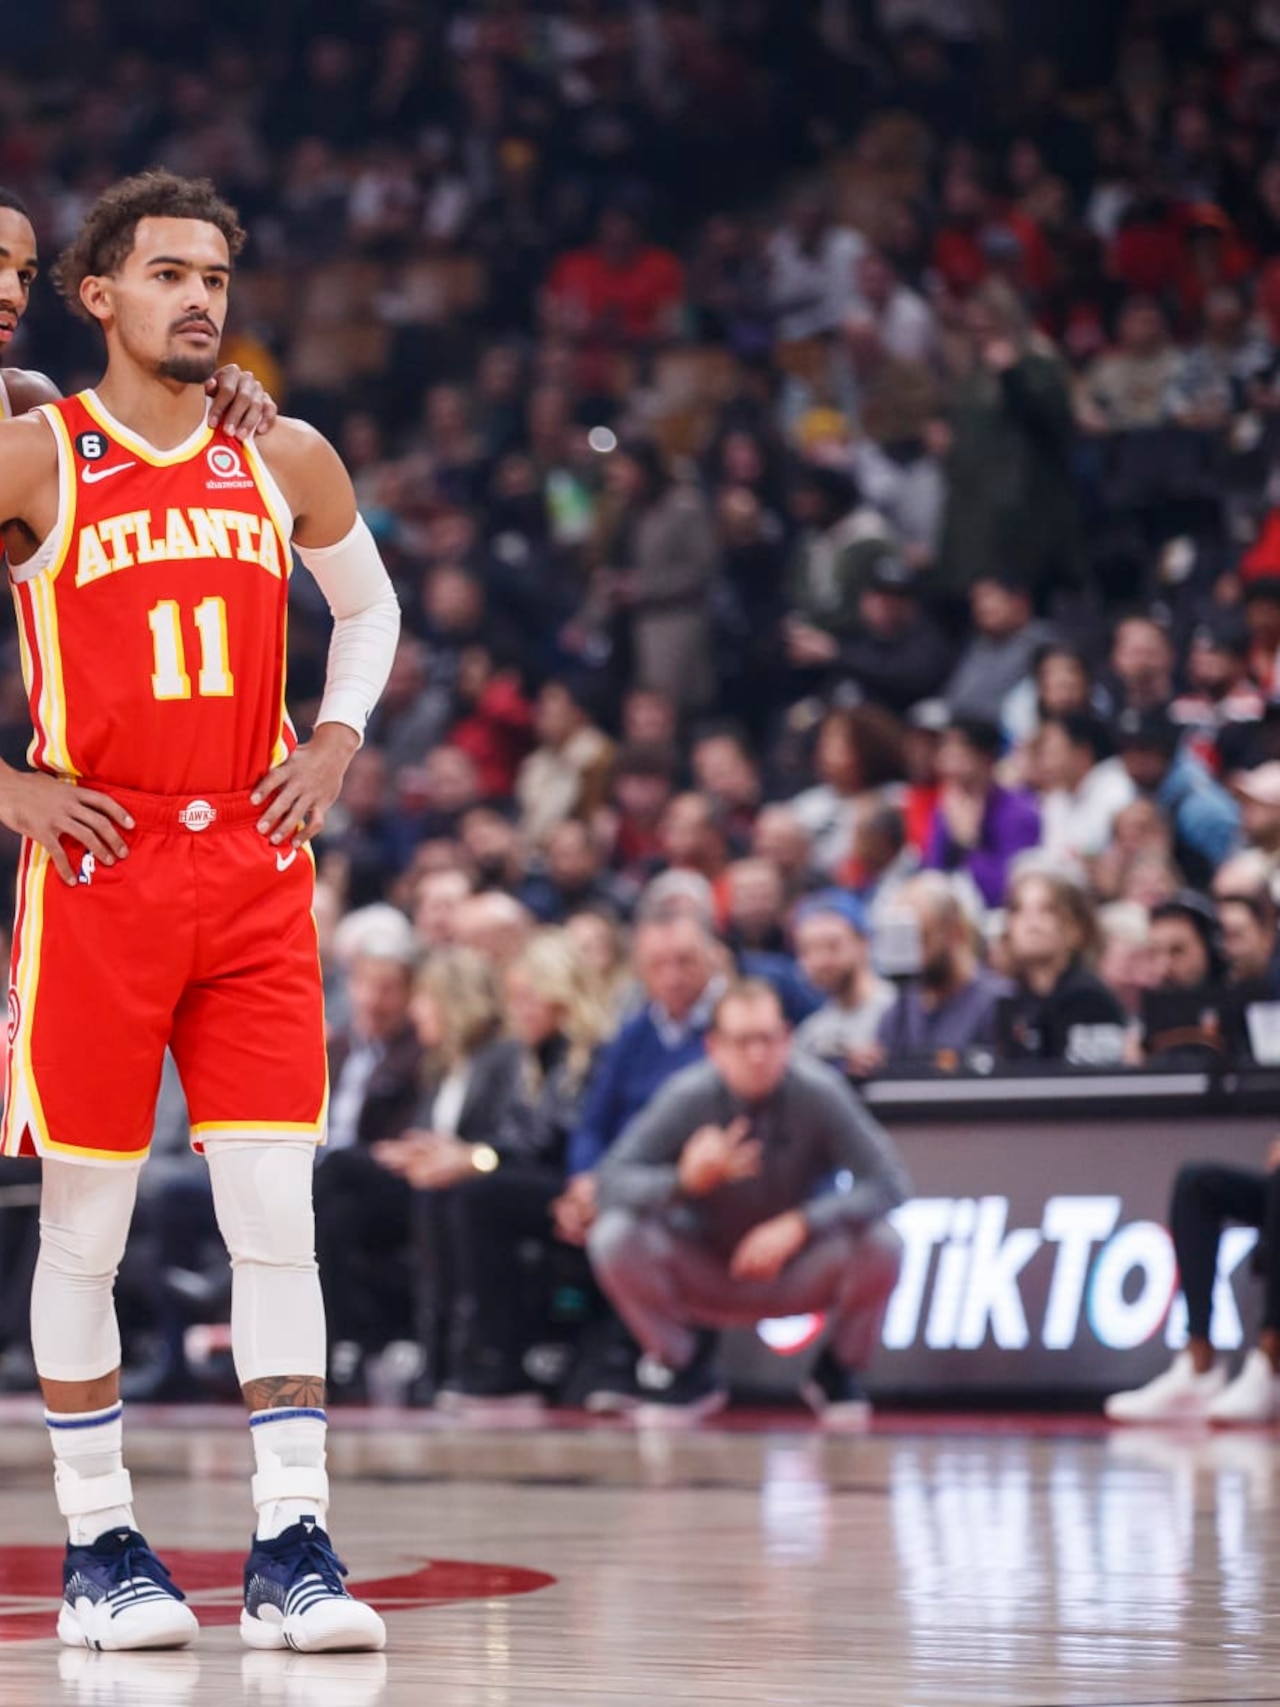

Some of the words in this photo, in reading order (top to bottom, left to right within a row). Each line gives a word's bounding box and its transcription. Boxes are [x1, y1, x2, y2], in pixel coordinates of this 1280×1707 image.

[81, 434, 102, 458] 6
[74, 507, 283, 589] ATLANTA
[147, 596, 235, 701] 11
